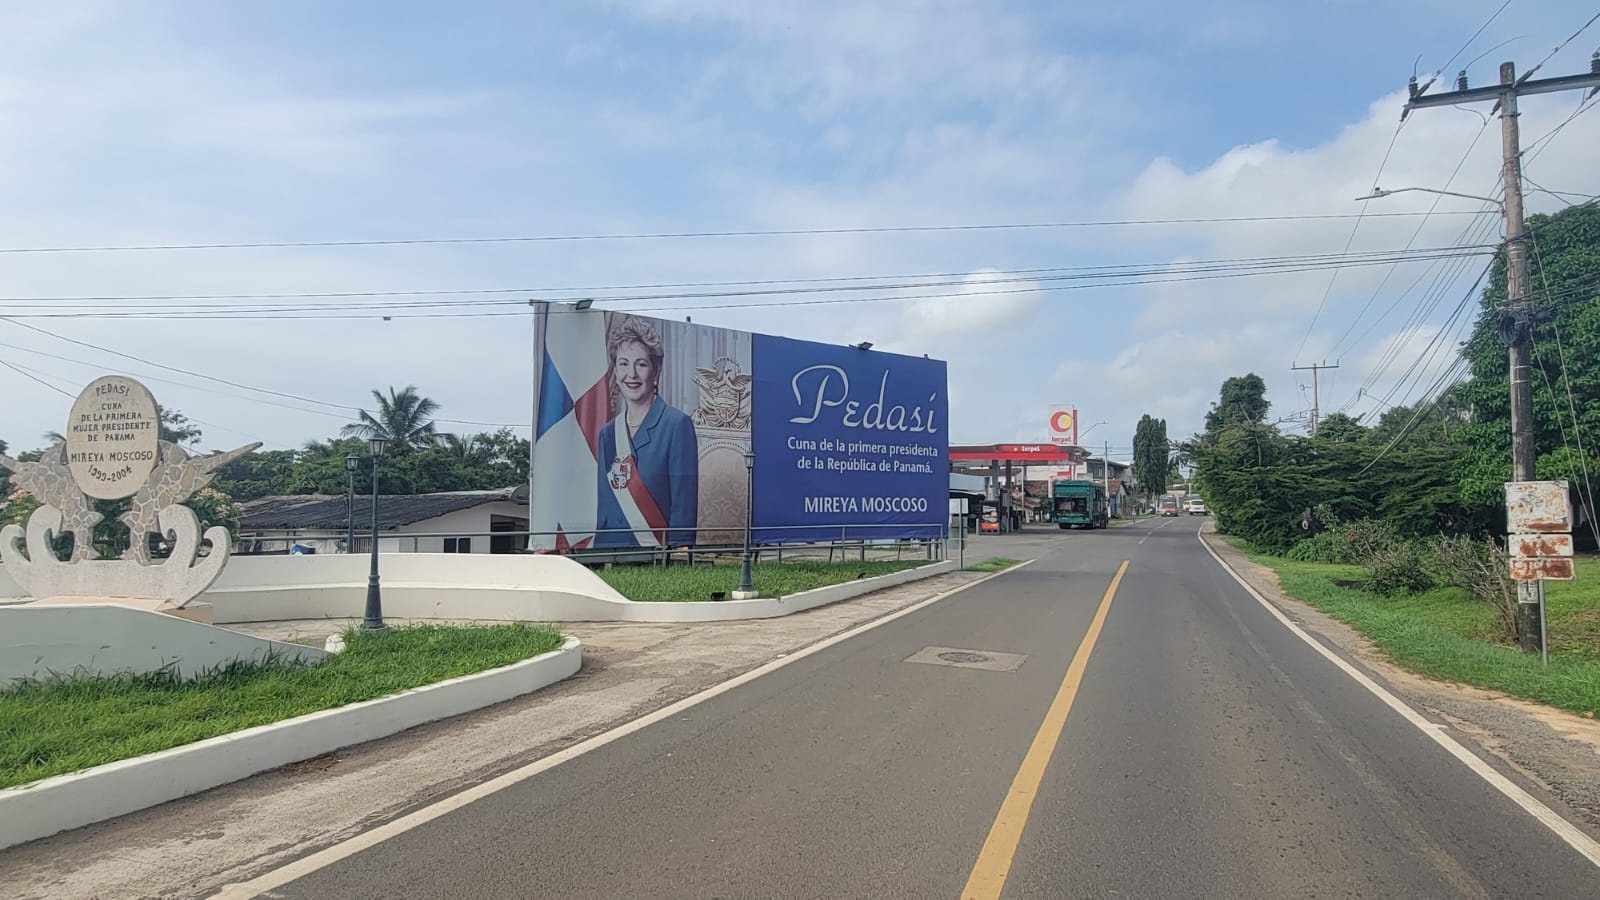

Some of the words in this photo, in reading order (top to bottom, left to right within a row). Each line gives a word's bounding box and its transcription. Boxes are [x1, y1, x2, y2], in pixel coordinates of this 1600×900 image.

[789, 364, 938, 434] Pedasí
[81, 414, 91, 422] DE
[106, 412, 142, 420] PRIMERA
[73, 424, 99, 432] MUJER
[102, 421, 151, 431] PRESIDENTE
[87, 434, 99, 442] DE
[104, 433, 136, 442] PANAMA
[787, 436, 817, 451] Cuna
[819, 438, 834, 452] de
[836, 438, 846, 452] la
[848, 440, 887, 456] primera
[889, 443, 938, 458] presidenta
[71, 452, 105, 463] MIREYA
[109, 450, 153, 461] MOSCOSO
[797, 455, 812, 470] de
[814, 456, 825, 470] la
[827, 457, 876, 474] República
[878, 459, 892, 473] de
[893, 460, 934, 474] Panamá.
[88, 465, 132, 482] 1999-2004
[804, 497, 859, 513] MIREYA
[861, 497, 929, 513] MOSCOSO
